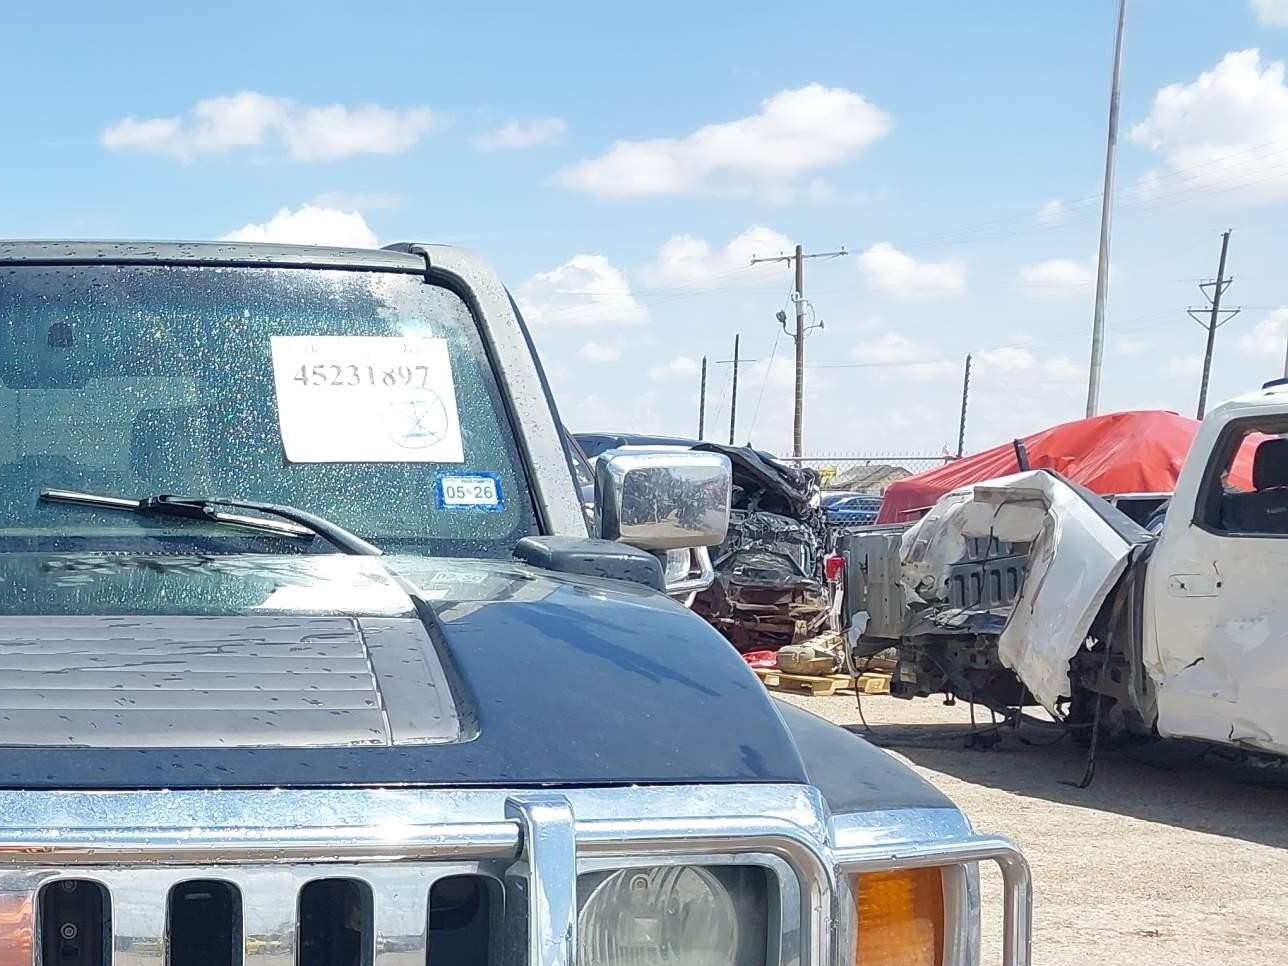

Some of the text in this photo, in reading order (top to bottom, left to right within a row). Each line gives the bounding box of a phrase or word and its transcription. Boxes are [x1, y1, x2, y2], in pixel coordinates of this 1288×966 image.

[293, 363, 430, 389] 45231897
[446, 486, 493, 499] 05 26
